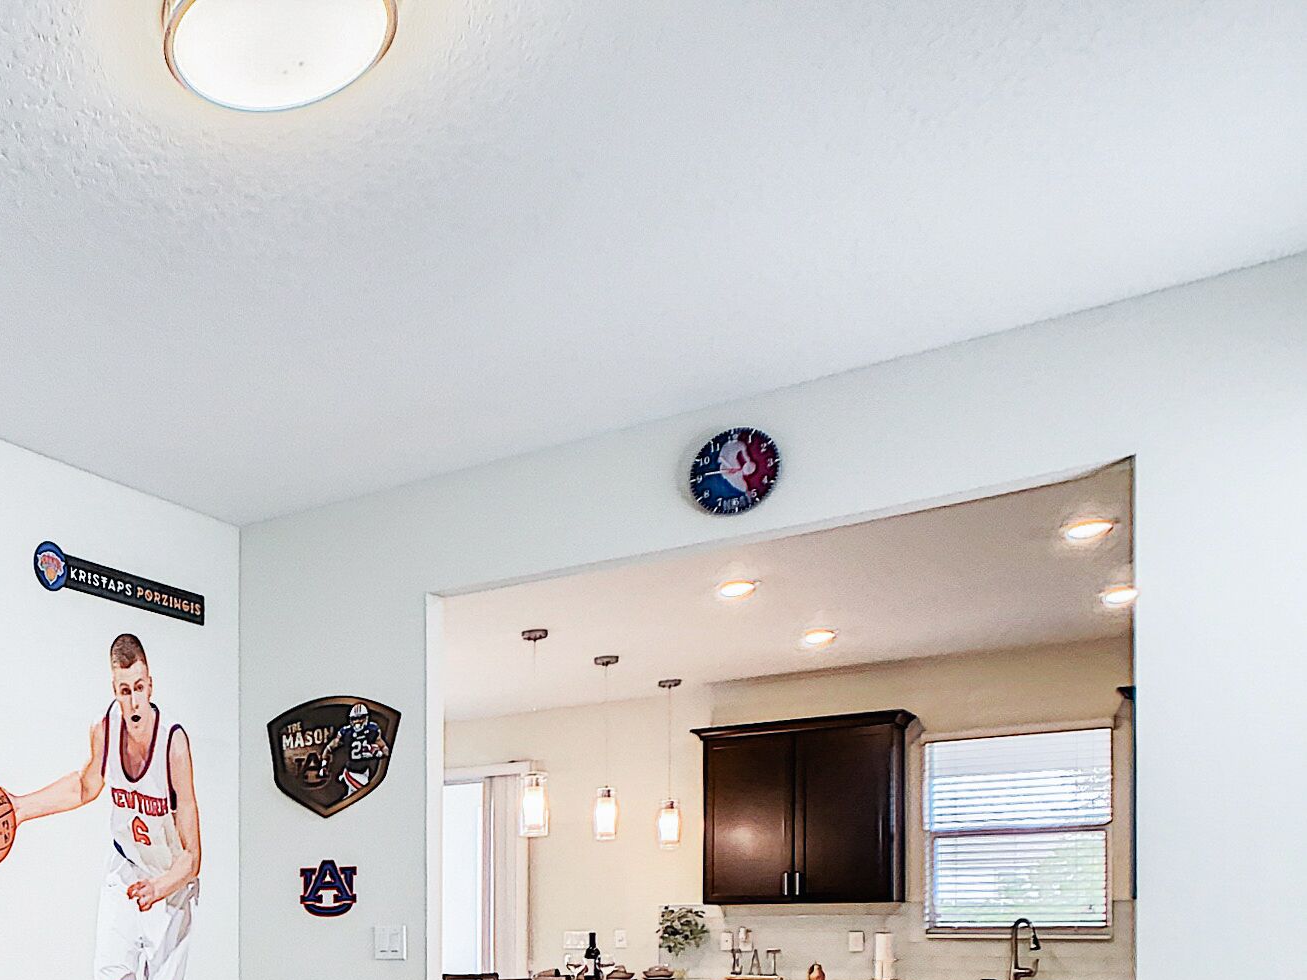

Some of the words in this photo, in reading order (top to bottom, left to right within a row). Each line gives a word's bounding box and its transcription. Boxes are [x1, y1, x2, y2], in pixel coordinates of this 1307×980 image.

[699, 456, 710, 466] 10
[70, 566, 132, 596] KRISTAPS
[136, 586, 202, 616] PORZINGIS
[282, 726, 333, 750] MASON
[731, 948, 781, 975] EAT
